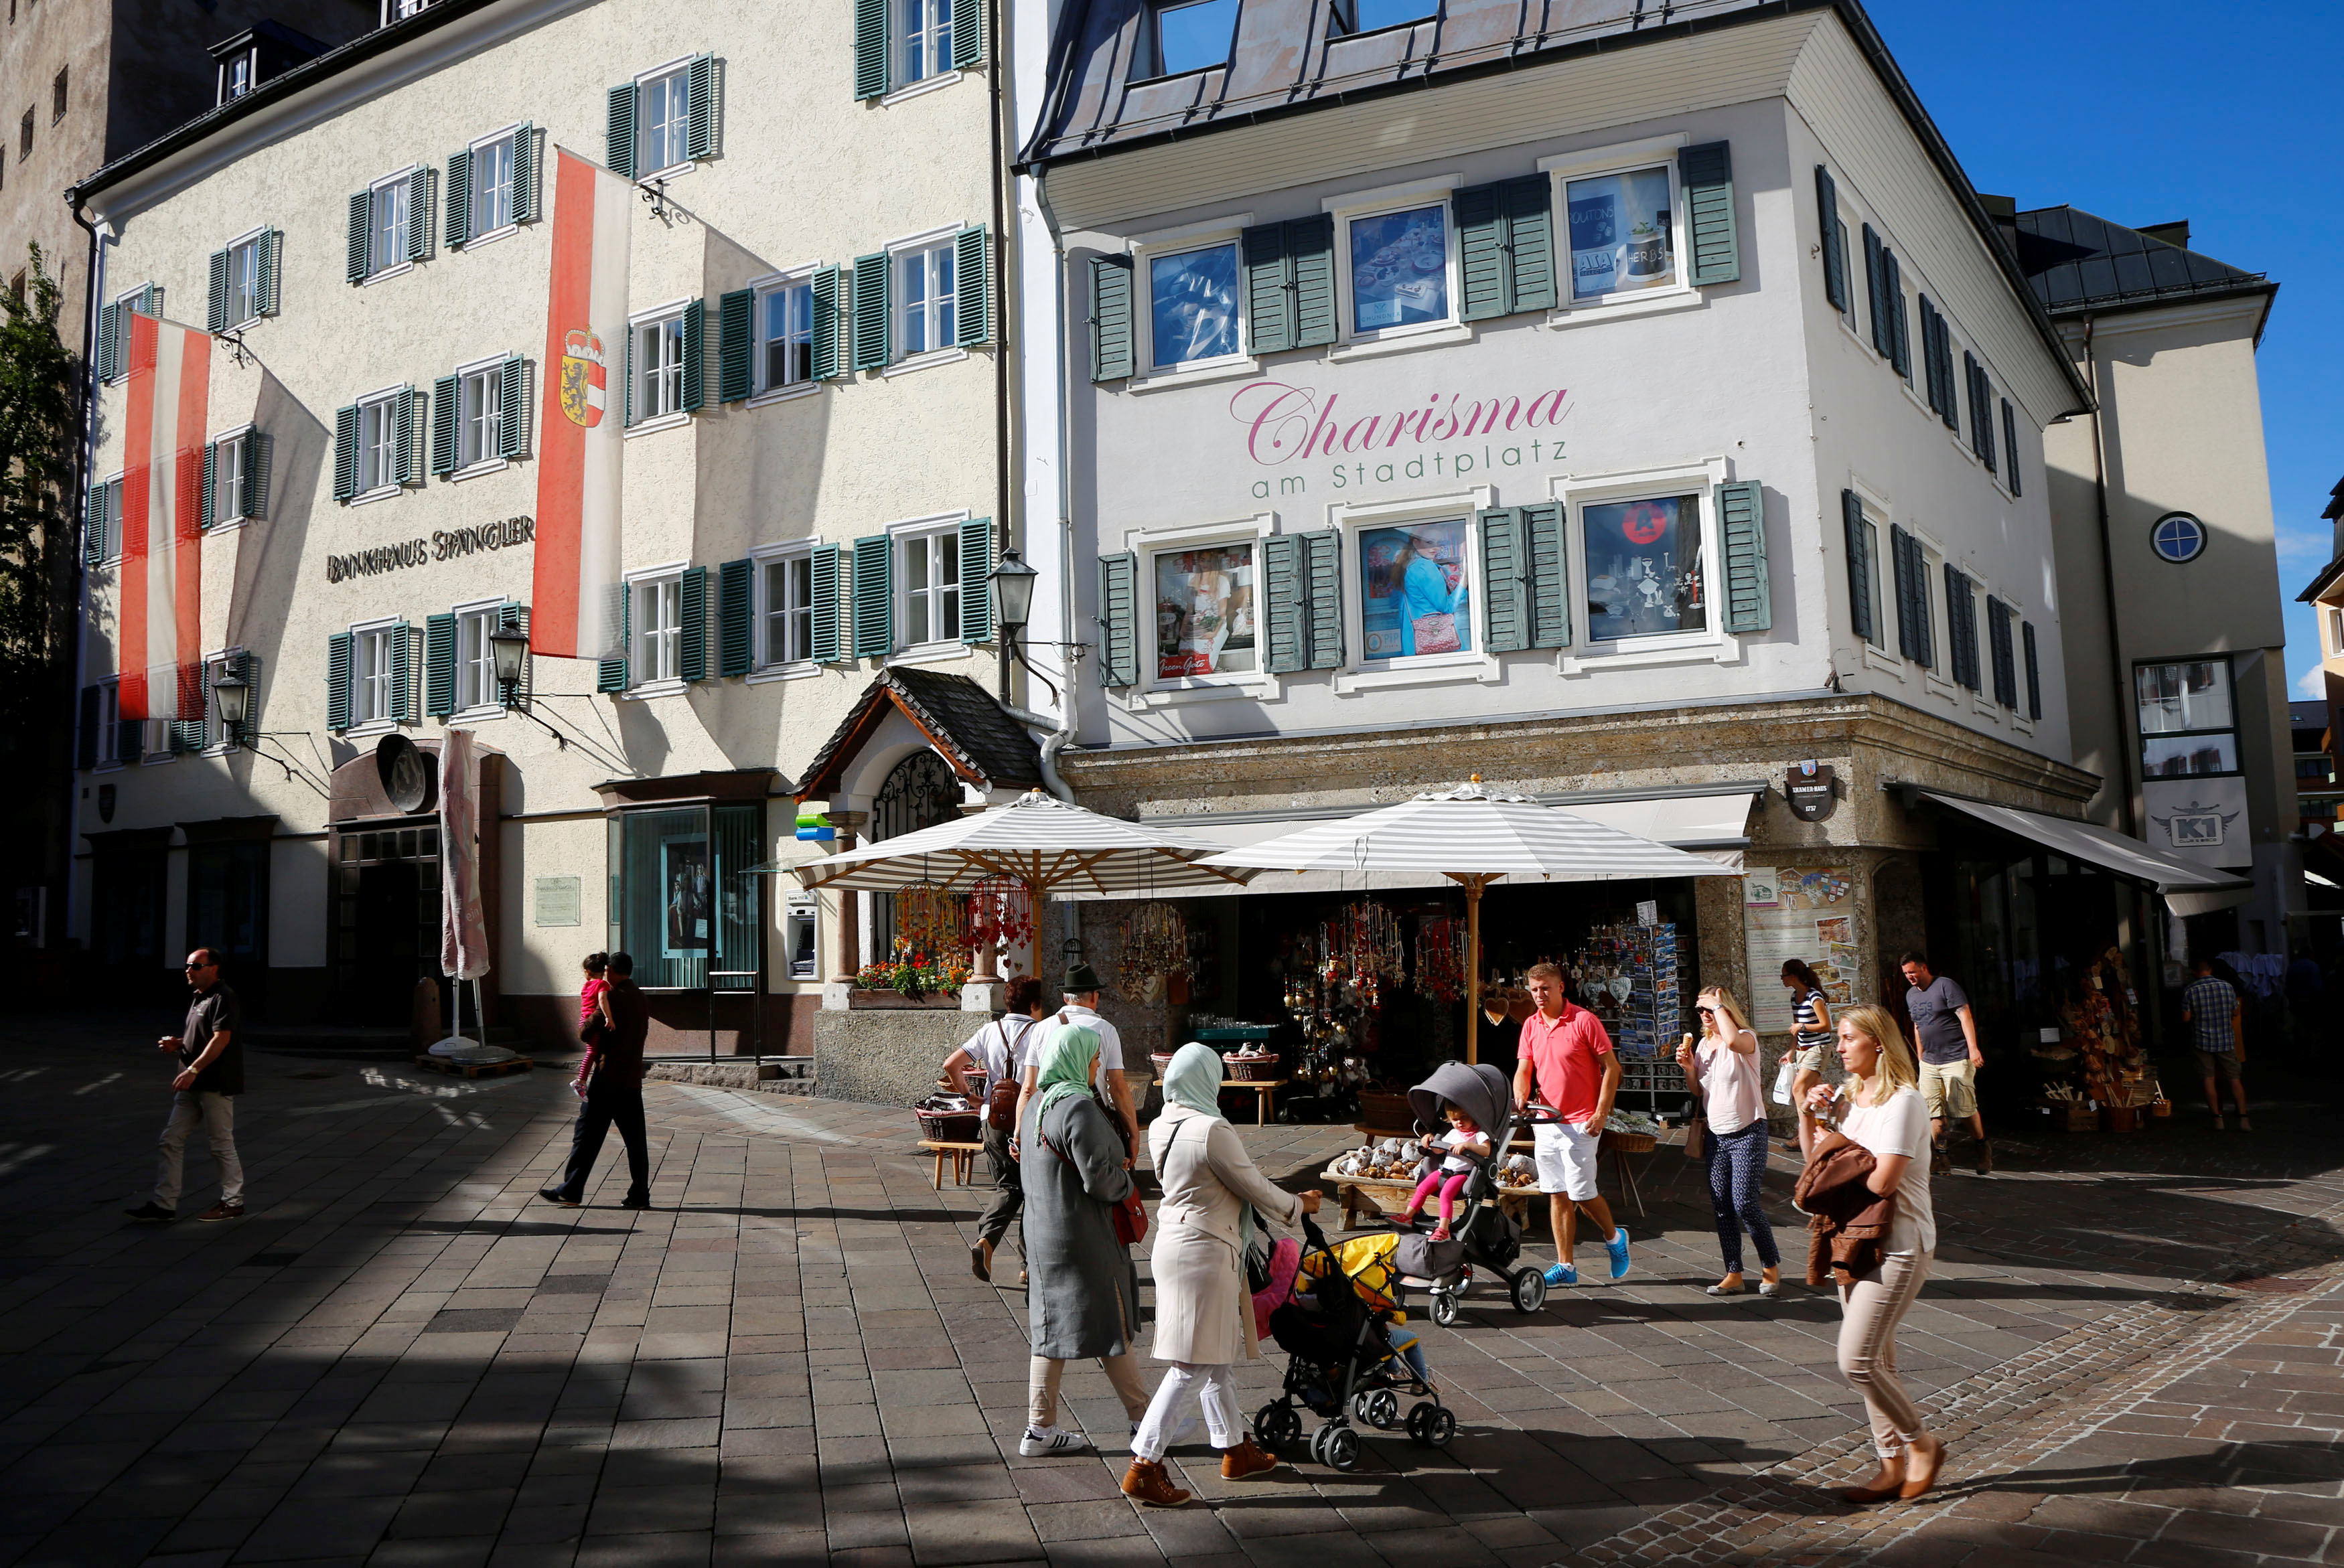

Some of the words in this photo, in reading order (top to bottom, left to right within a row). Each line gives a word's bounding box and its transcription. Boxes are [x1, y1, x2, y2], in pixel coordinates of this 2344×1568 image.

[1628, 247, 1663, 262] HERBS
[1230, 382, 1574, 465] Charisma
[1252, 475, 1305, 499] am
[1332, 439, 1567, 489] Stadtplatz
[327, 538, 425, 580] BANKHAUS
[2176, 817, 2216, 838] K1
